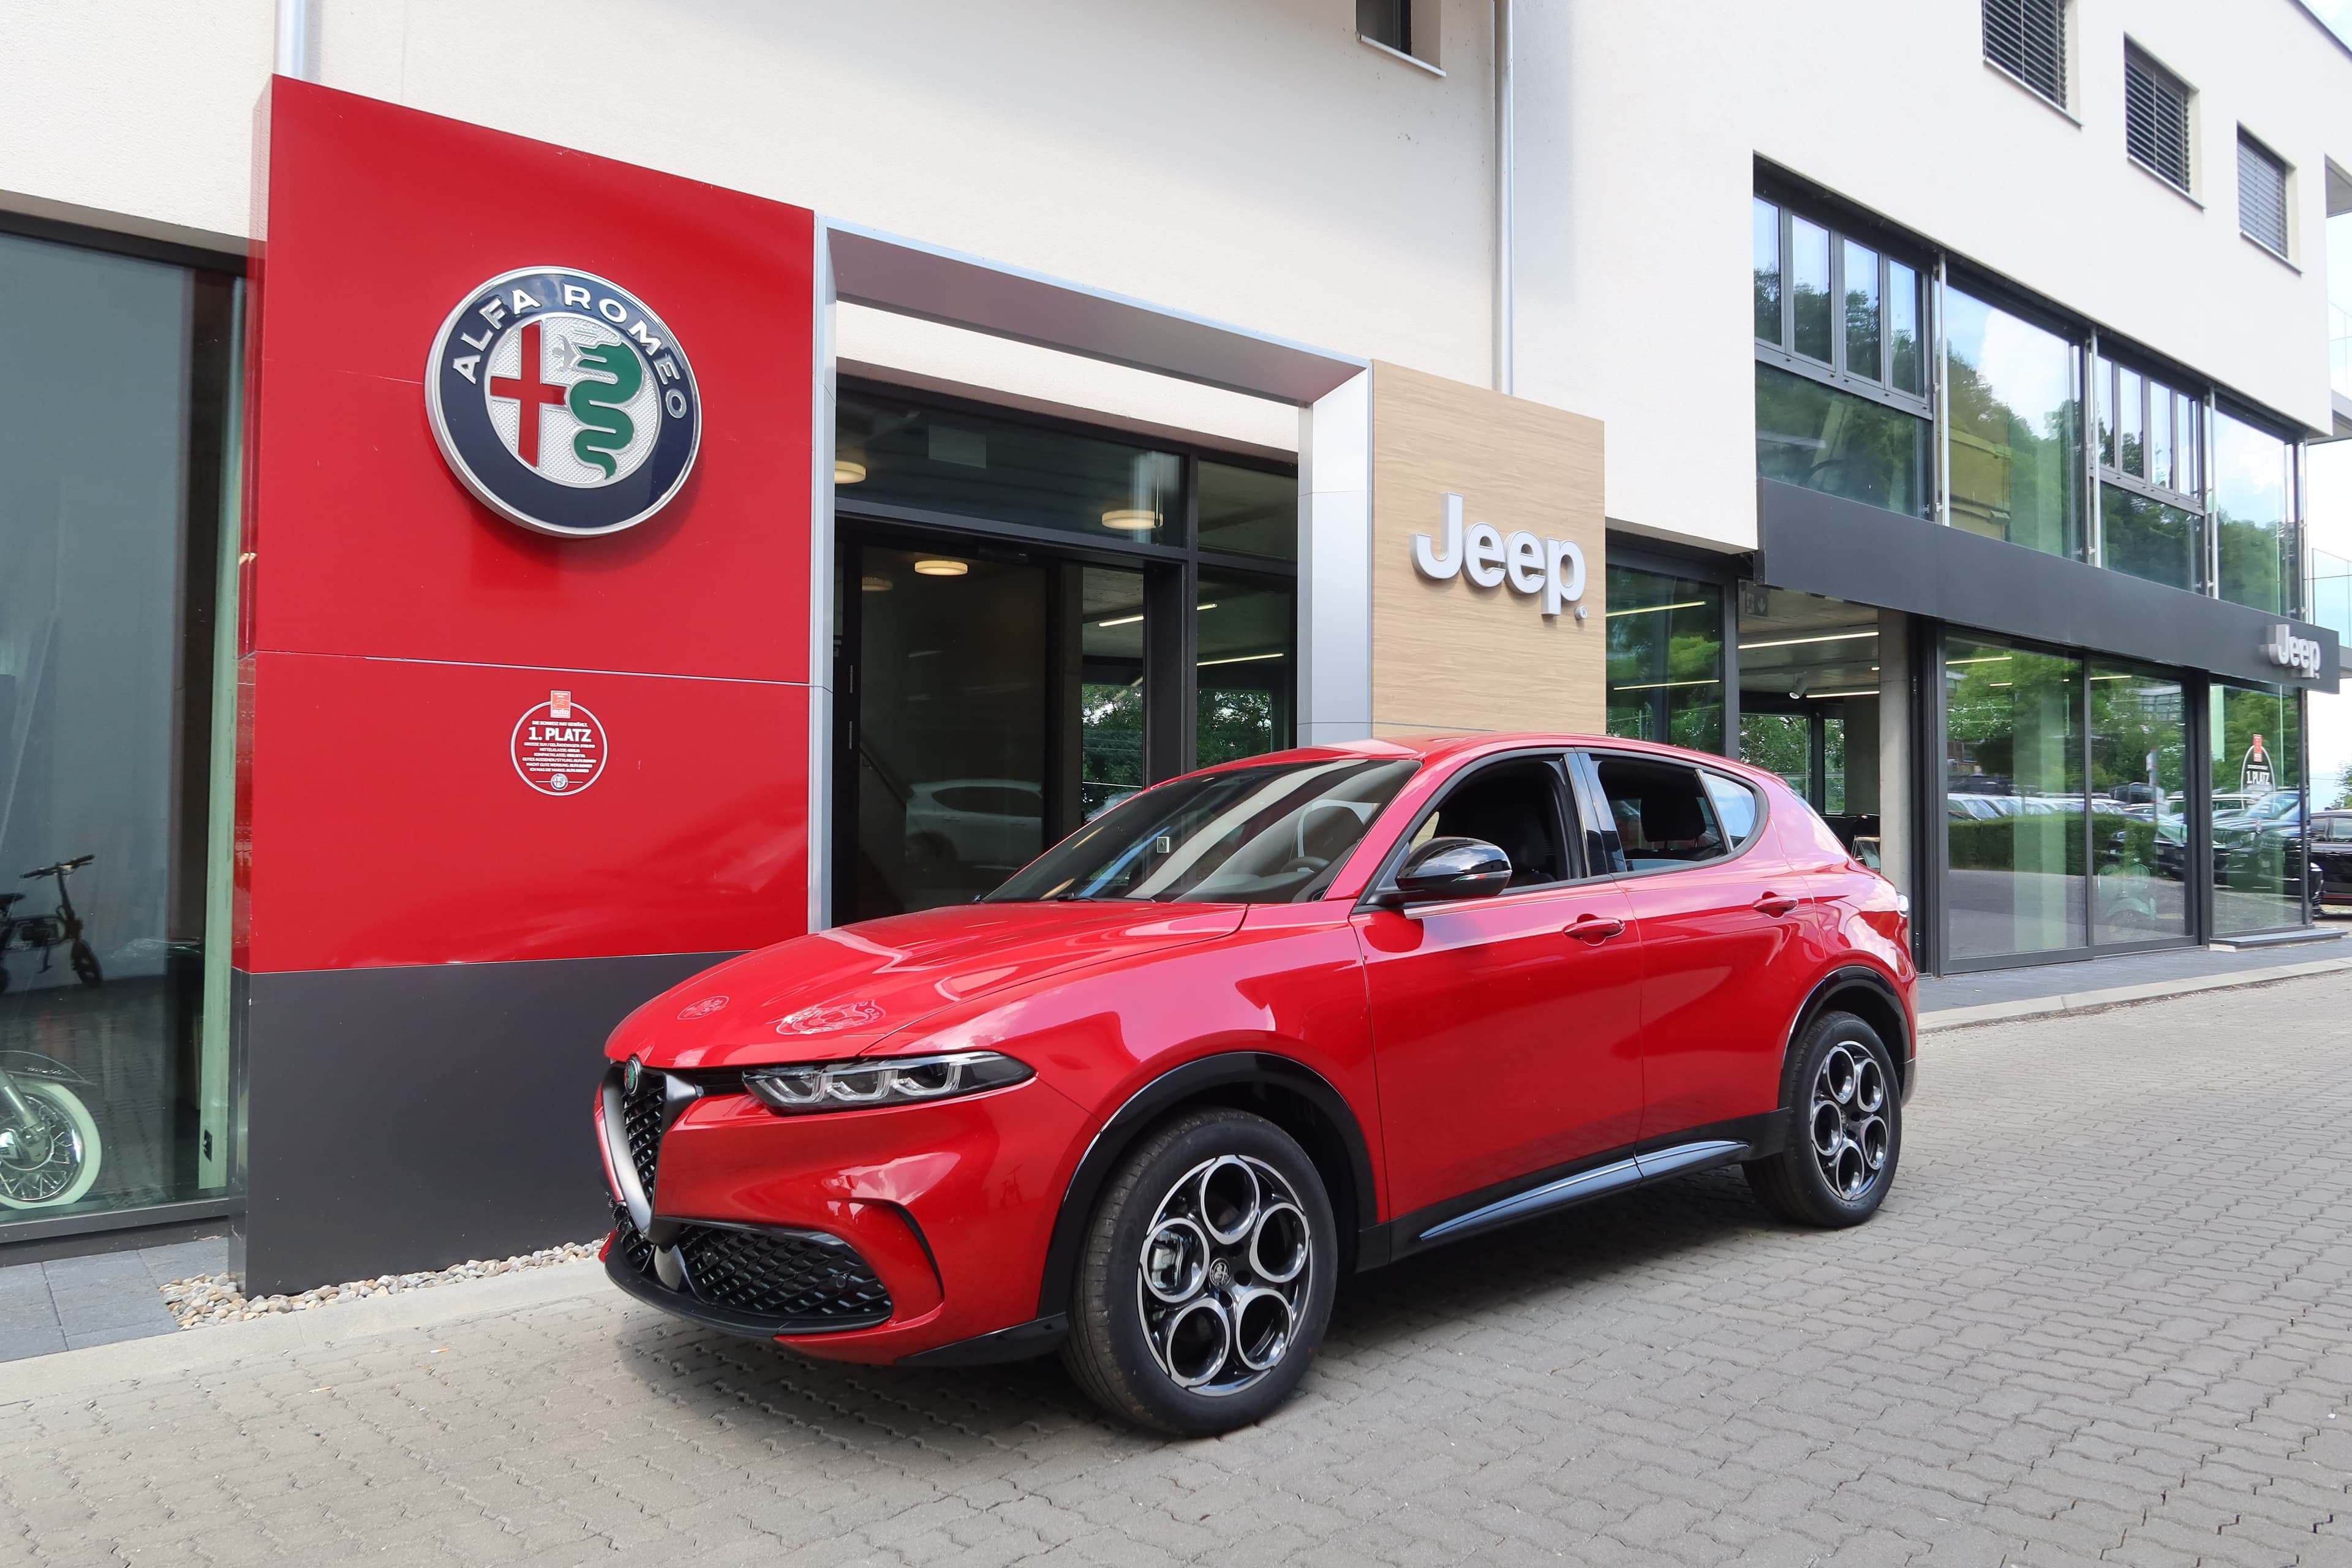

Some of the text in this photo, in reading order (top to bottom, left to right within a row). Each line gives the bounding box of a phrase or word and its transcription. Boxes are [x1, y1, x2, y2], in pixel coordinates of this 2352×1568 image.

[452, 284, 688, 419] ALFA ROMEO
[1411, 492, 1587, 616] Jeep
[2263, 624, 2320, 678] Jeep
[529, 727, 592, 742] 1. PLATZ
[2252, 771, 2270, 785] PLATZ
